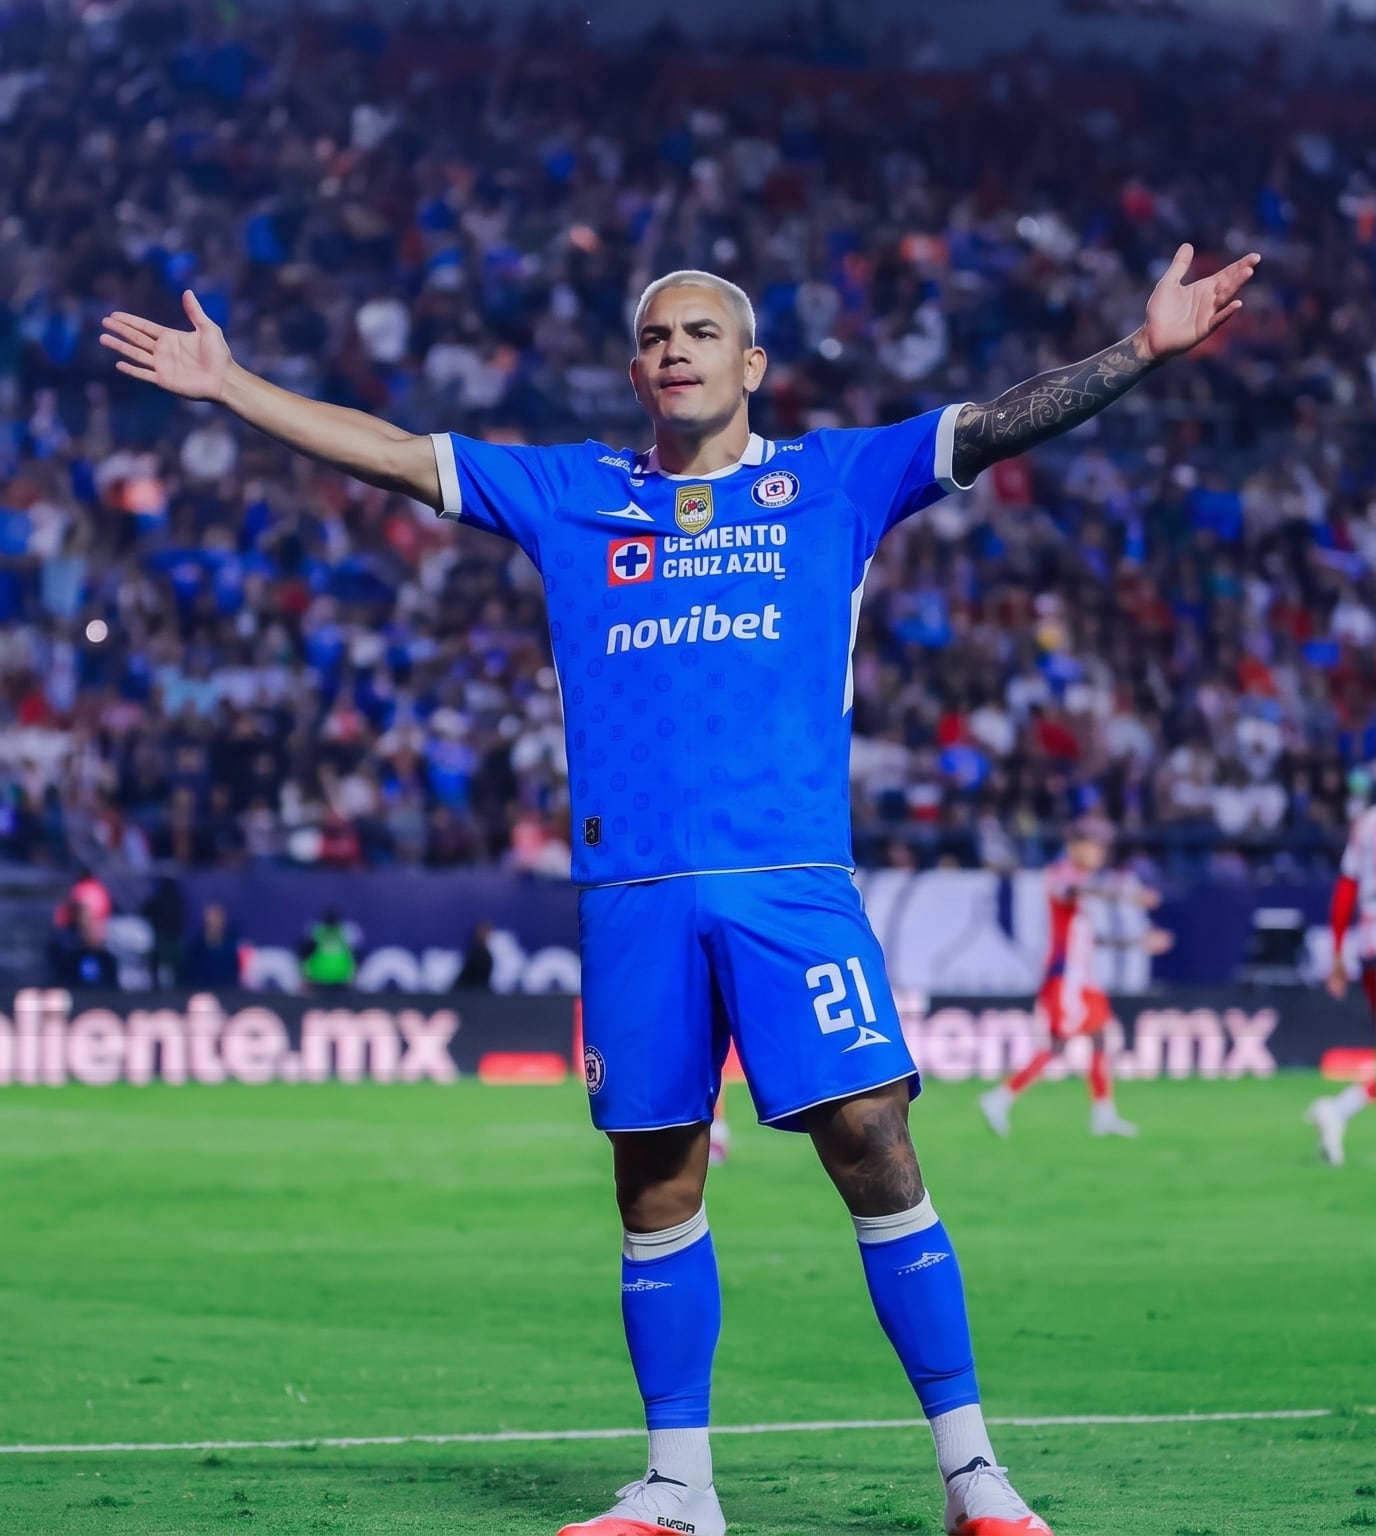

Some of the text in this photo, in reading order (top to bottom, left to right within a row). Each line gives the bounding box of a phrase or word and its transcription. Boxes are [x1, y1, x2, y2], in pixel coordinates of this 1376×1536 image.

[662, 551, 786, 579] CRUZ AZUL
[663, 524, 787, 553] CEMENTO
[606, 602, 782, 656] novibet
[805, 956, 877, 1035] 21
[0, 987, 459, 1086] liente.mx
